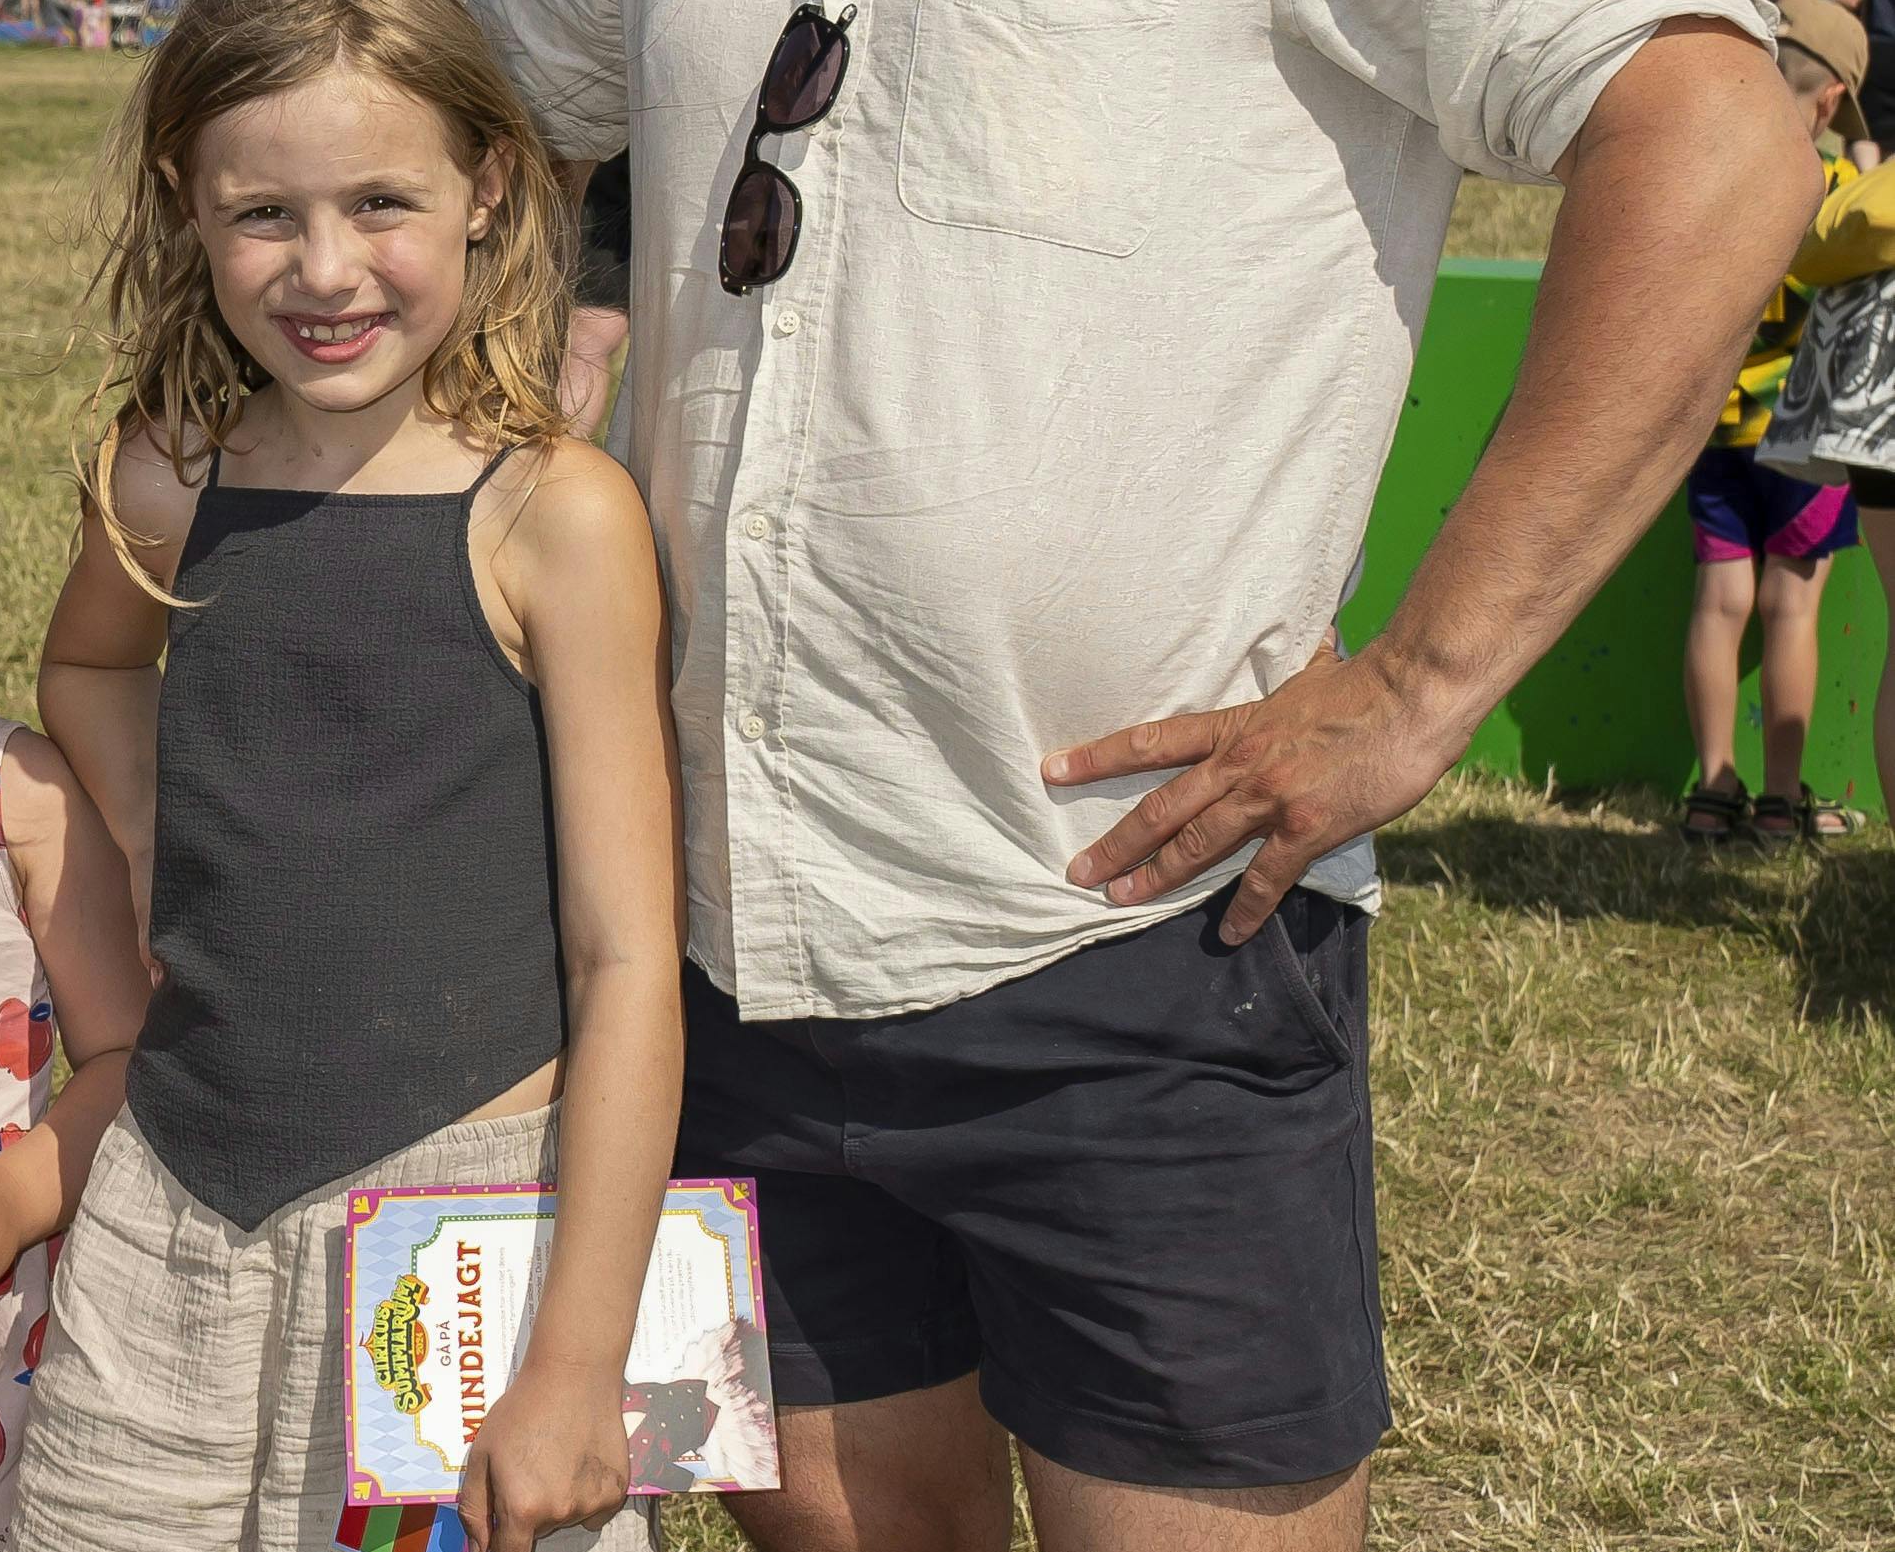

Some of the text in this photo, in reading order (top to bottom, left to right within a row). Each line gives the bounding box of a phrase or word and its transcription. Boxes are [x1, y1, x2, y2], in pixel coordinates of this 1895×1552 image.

[373, 1304, 392, 1387] CIRKUS
[393, 1275, 421, 1413] SUMMARUM
[436, 1320, 452, 1367] GÅ PÅ
[457, 1240, 485, 1445] MINDEJAGT
